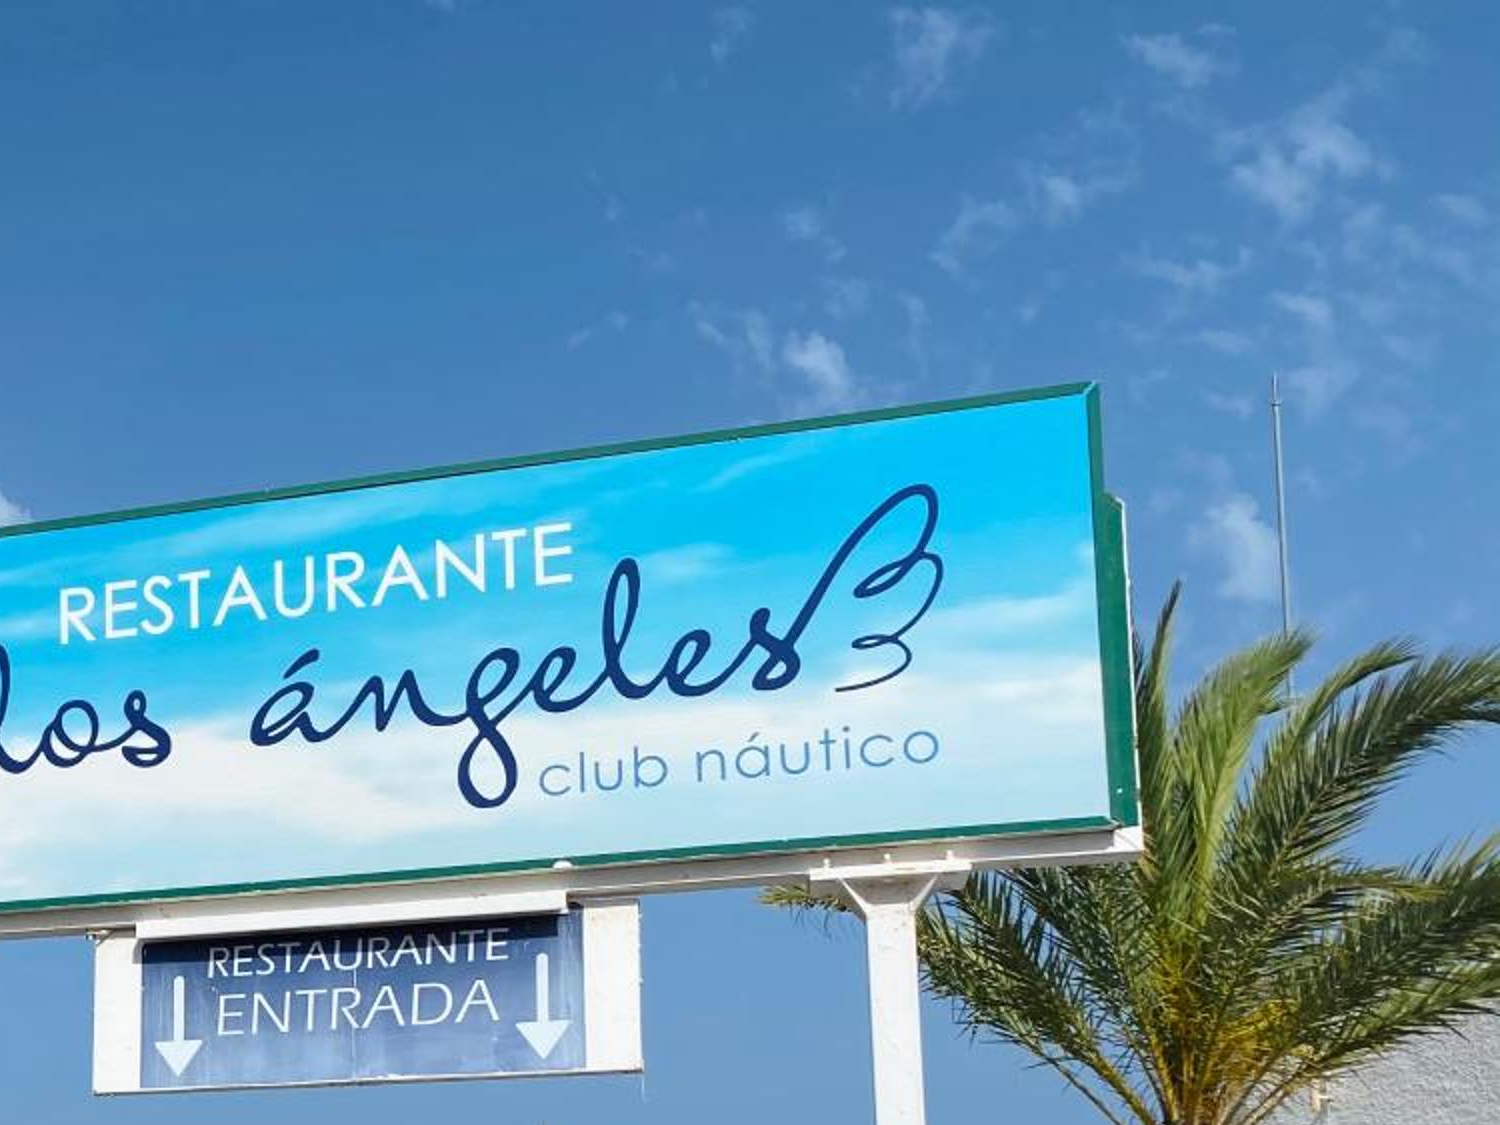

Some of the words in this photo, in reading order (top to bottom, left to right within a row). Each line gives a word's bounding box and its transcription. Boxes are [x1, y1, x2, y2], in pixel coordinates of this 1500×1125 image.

[58, 523, 573, 645] RESTAURANTE
[249, 557, 810, 808] ángeles
[539, 747, 668, 797] club
[695, 725, 940, 784] náutico
[207, 927, 509, 979] RESTAURANTE
[217, 979, 501, 1036] ENTRADA
